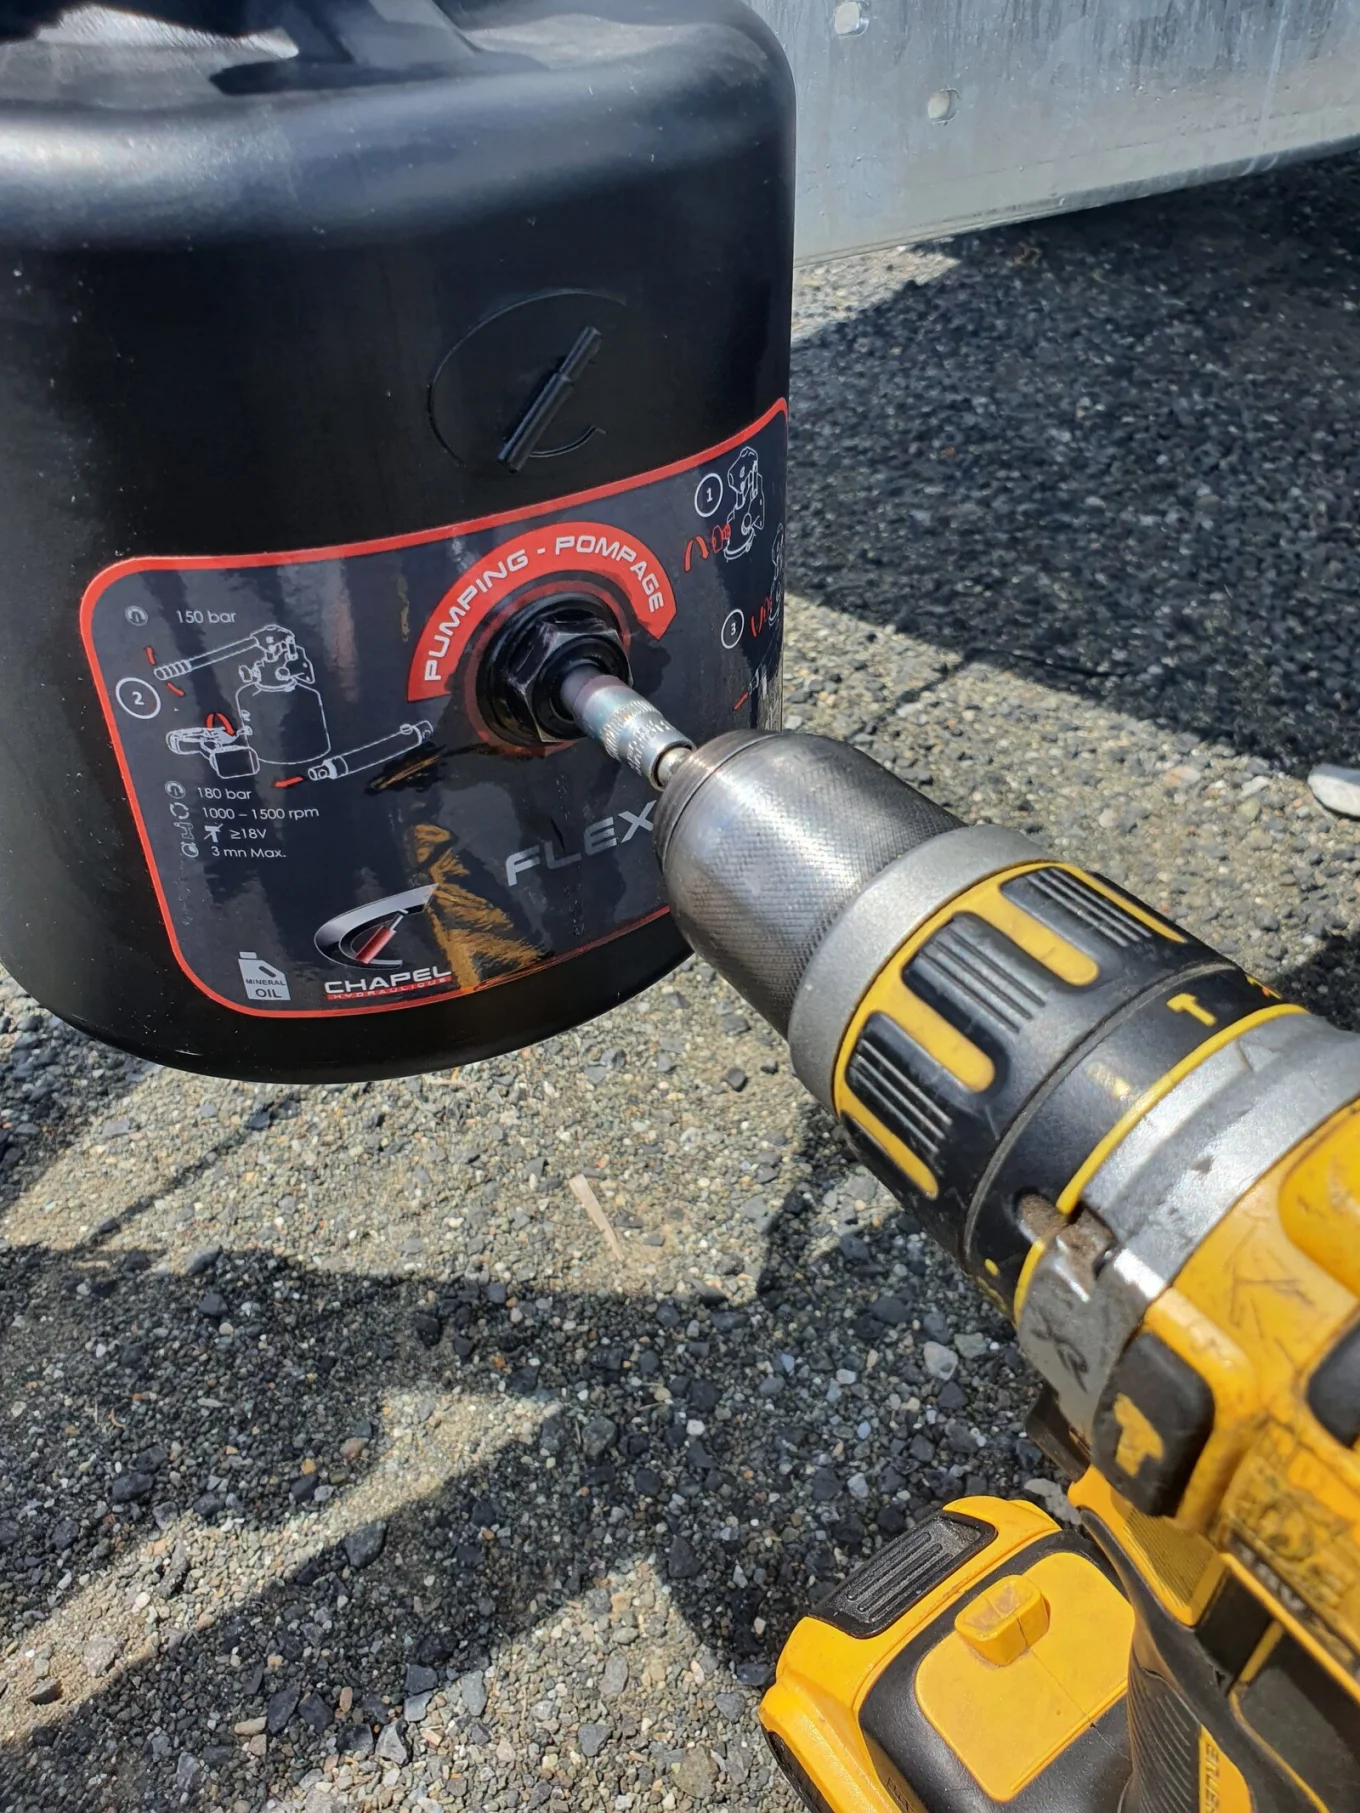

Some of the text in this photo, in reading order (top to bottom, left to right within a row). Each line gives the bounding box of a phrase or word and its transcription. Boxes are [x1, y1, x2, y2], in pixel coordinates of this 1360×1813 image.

[706, 487, 713, 503] 1
[424, 549, 529, 681] PUMPING
[555, 535, 664, 613] POMPAGE
[176, 610, 237, 624] 150 bar
[730, 622, 737, 635] 3
[132, 691, 145, 706] 2
[197, 787, 252, 800] 180 bar
[202, 807, 235, 820] 1000
[251, 808, 286, 820] 1500
[288, 808, 320, 821] rpm
[505, 800, 657, 887] FLEX
[211, 846, 287, 858] 3 mn Max.
[245, 978, 287, 986] MINERAL
[324, 965, 452, 994] CHAPEL
[255, 988, 282, 998] OIL
